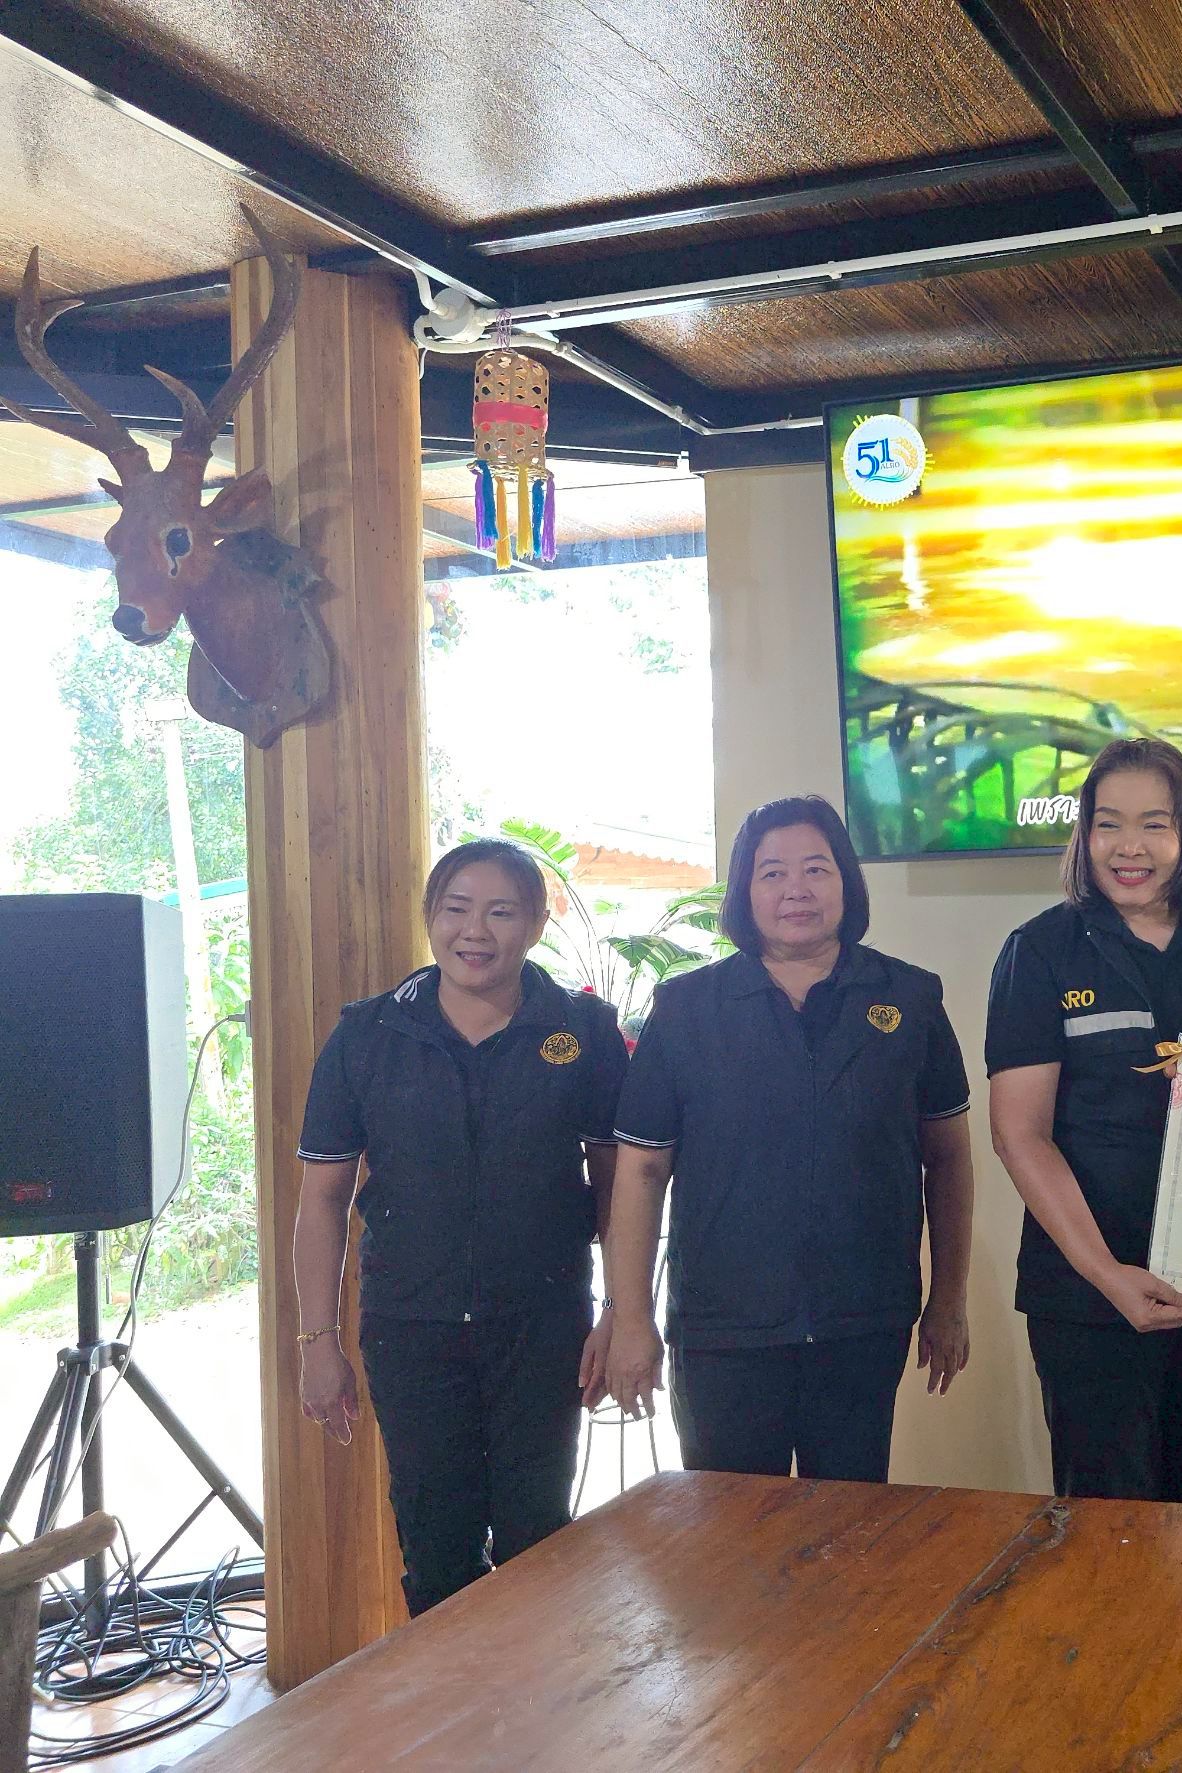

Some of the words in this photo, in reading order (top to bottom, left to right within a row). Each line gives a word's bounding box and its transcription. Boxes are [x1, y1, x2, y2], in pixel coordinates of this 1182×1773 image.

[856, 438, 894, 478] 51
[1018, 796, 1080, 825] เพราะ
[1061, 989, 1095, 1011] RO
